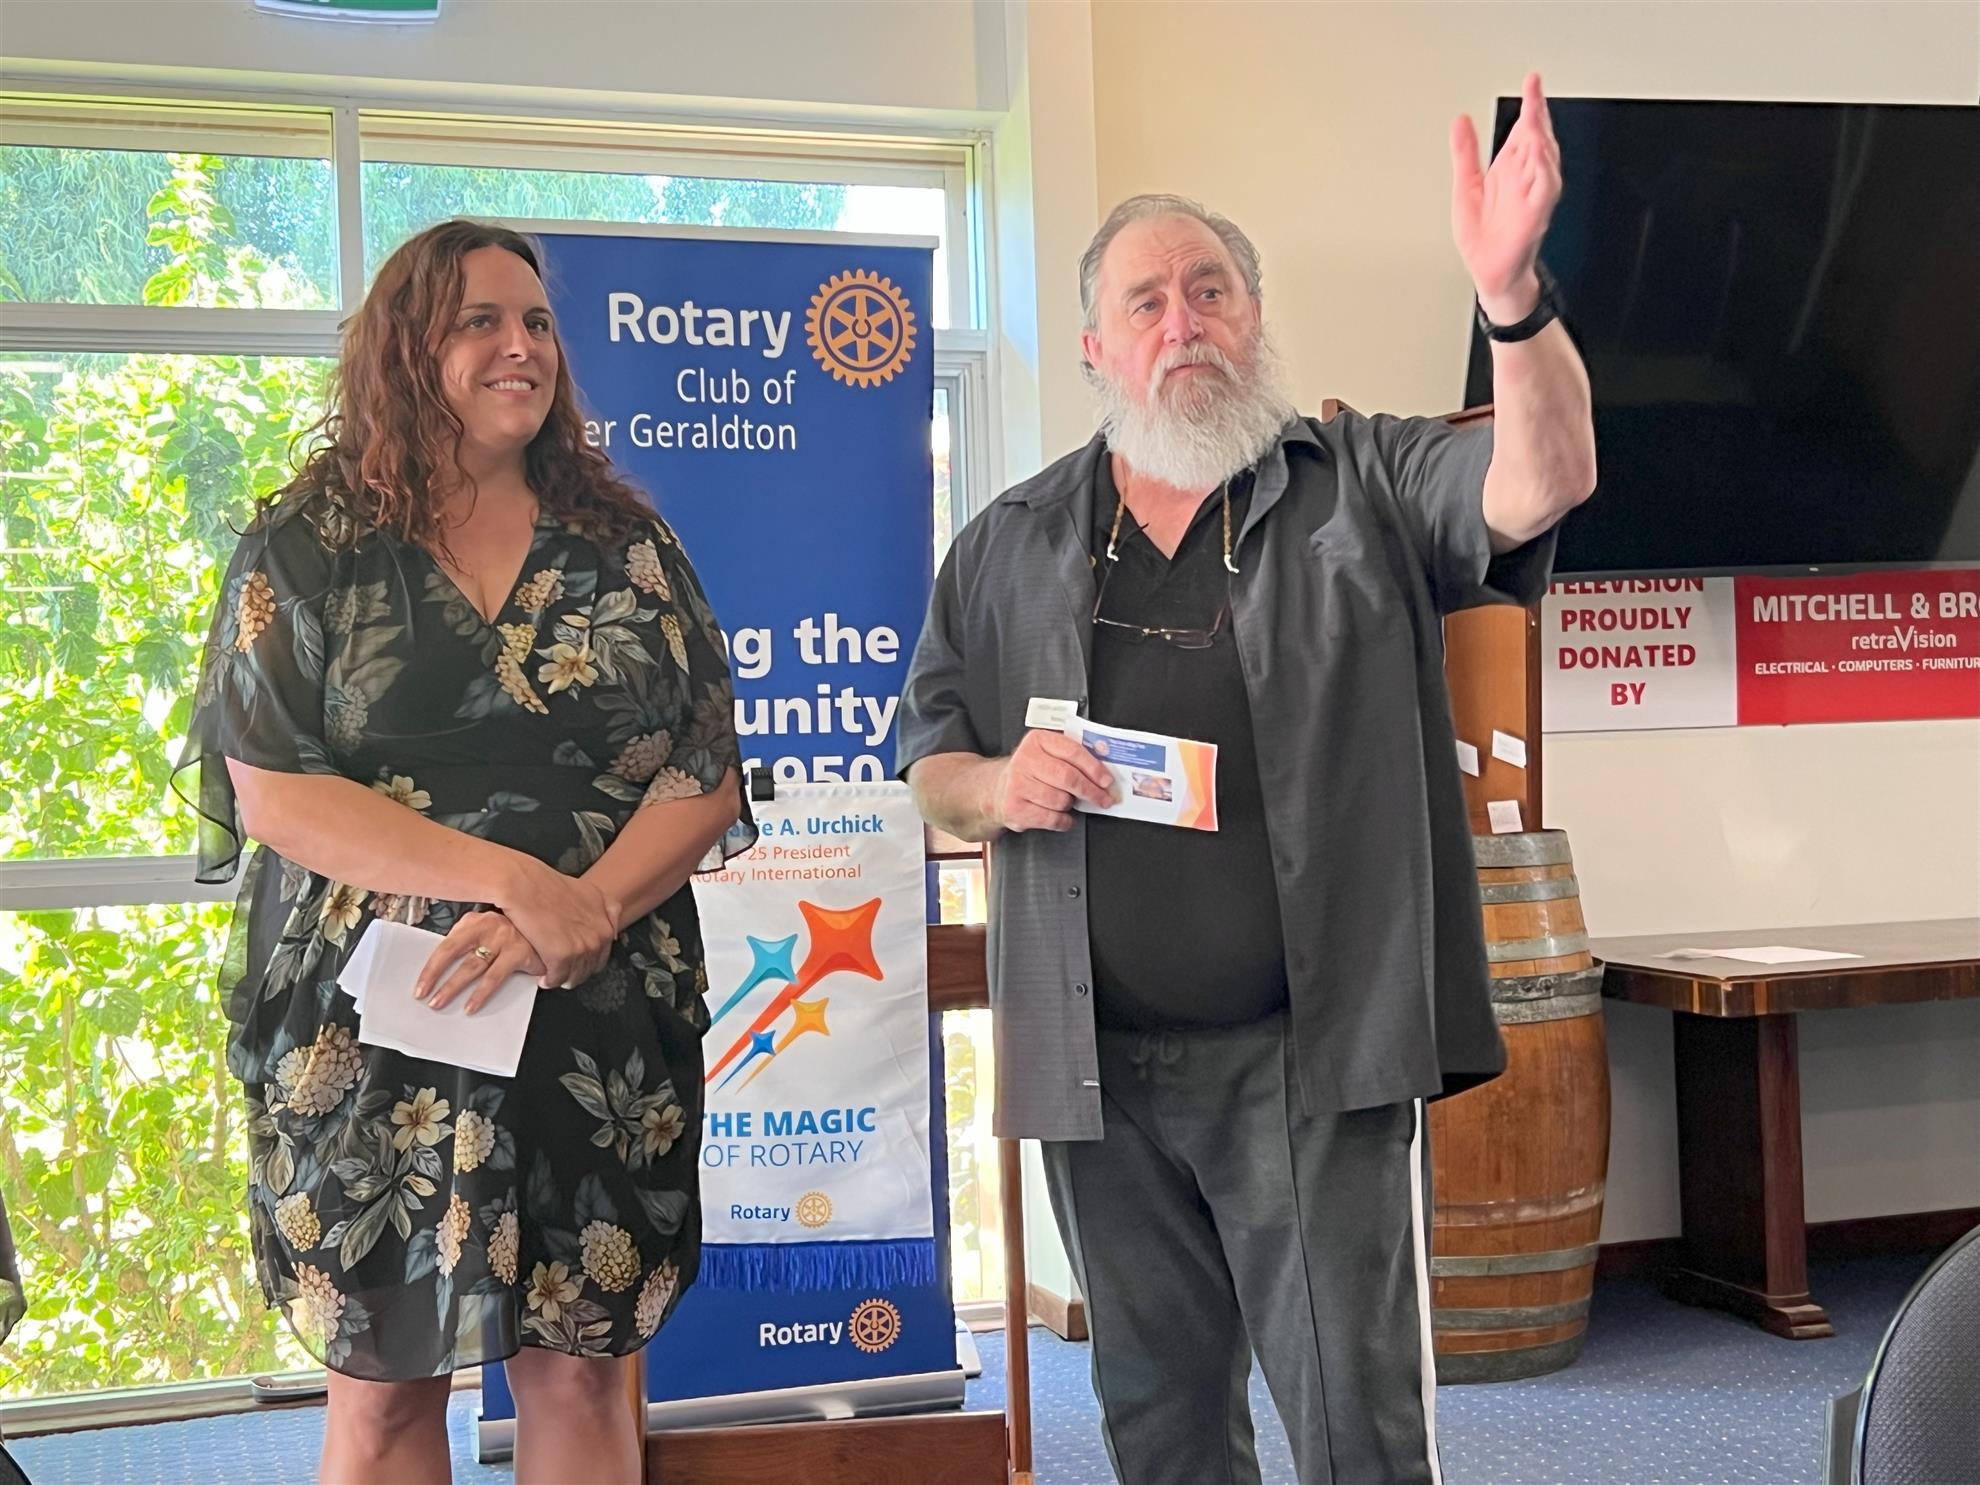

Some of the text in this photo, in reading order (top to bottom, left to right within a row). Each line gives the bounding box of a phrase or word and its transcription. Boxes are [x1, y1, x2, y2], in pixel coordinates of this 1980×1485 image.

[608, 292, 791, 359] Rotary
[677, 368, 797, 405] Club of
[630, 413, 796, 450] Geraldton
[1561, 607, 1692, 632] PROUDLY
[1753, 592, 1980, 622] MITCHELL & BR
[794, 613, 900, 664] the
[1852, 625, 1957, 652] retraVision
[1559, 644, 1696, 669] DONATED
[1755, 661, 1829, 675] ELECTRICAL
[1838, 659, 1913, 672] COMPUTERS
[1611, 682, 1646, 706] BY
[734, 684, 900, 746] unity
[780, 818, 800, 836] A.
[807, 814, 884, 835] Urchick
[774, 844, 851, 860] President
[752, 864, 862, 880] International
[704, 1107, 876, 1137] HE MAGIC
[703, 1140, 864, 1168] OF ROTARY
[731, 1204, 791, 1222] Rotary
[760, 1321, 843, 1347] Rotary
